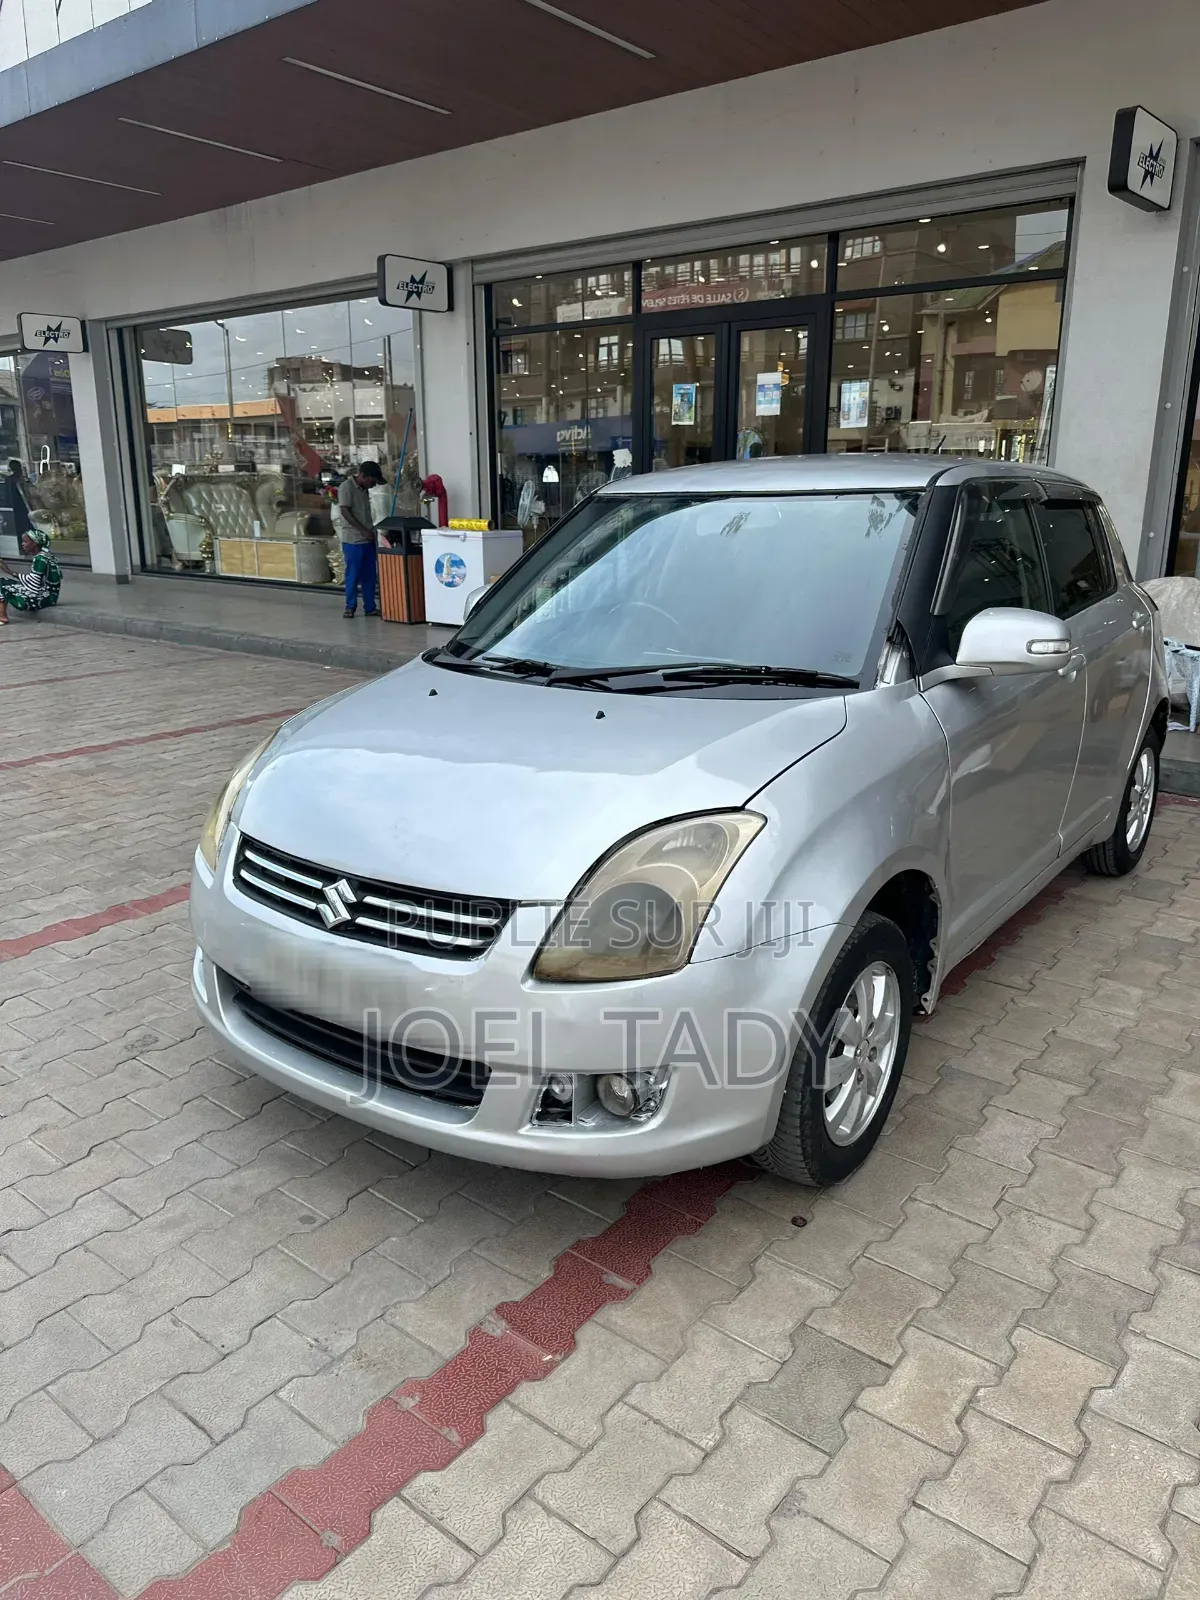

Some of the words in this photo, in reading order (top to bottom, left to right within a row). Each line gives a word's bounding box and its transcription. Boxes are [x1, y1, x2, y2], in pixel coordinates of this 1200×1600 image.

[1138, 153, 1165, 178] ELECTRO
[398, 281, 433, 294] ELECTRO
[36, 330, 69, 338] ELECTRO
